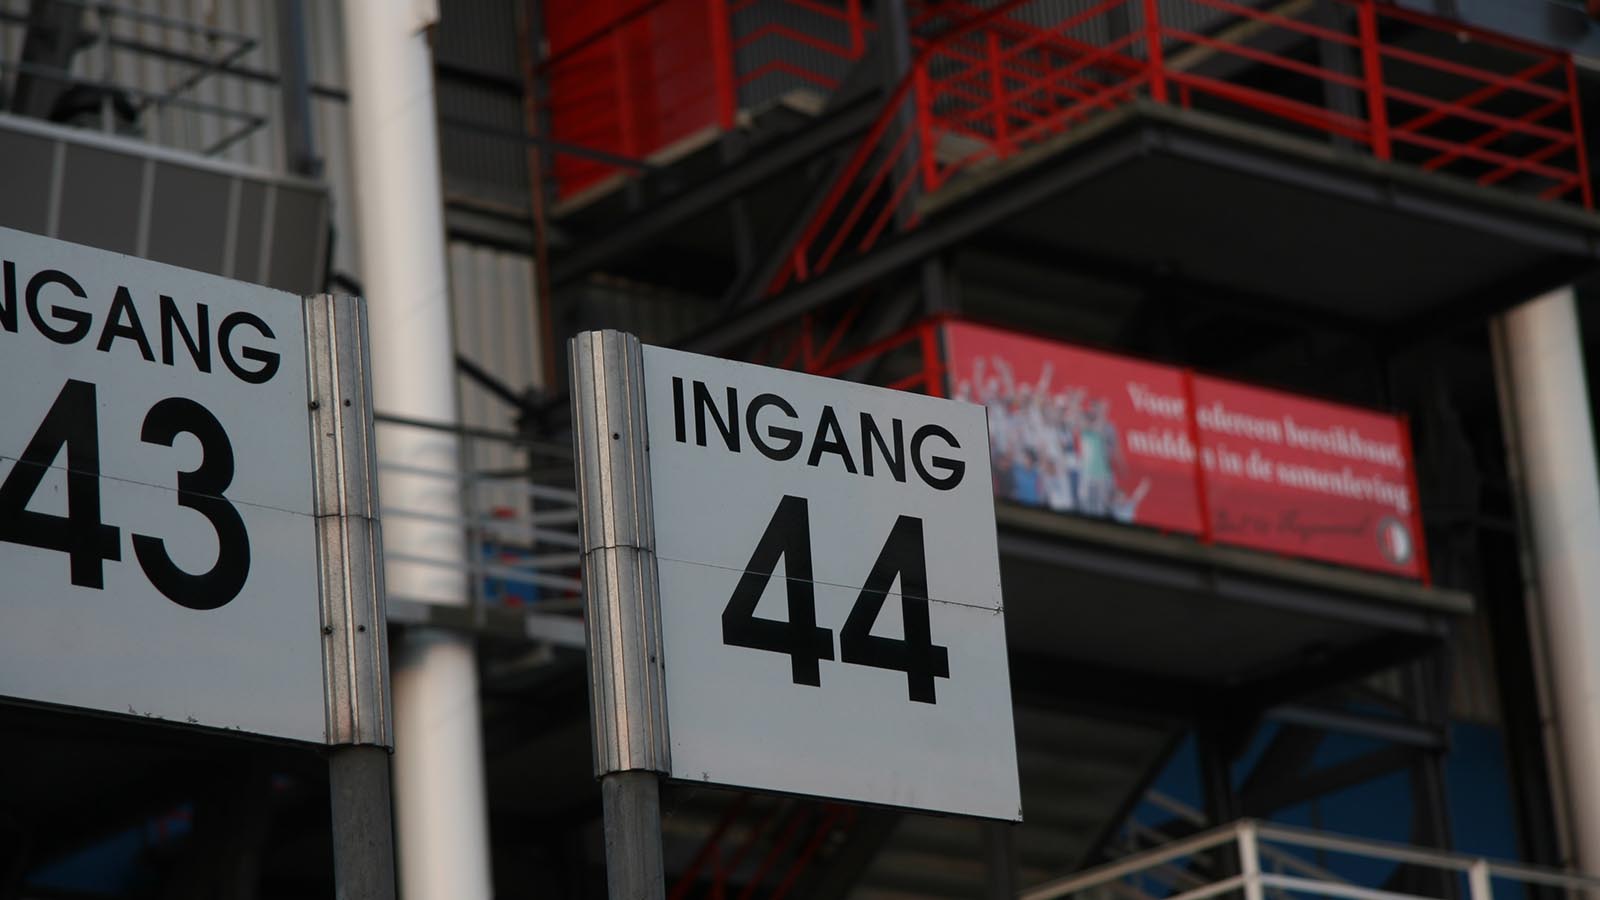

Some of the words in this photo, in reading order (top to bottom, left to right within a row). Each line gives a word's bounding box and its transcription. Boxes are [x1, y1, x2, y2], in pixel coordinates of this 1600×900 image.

[672, 376, 966, 491] INGANG
[1126, 381, 1185, 421] Voor
[1194, 401, 1282, 445] edereen
[0, 378, 251, 611] 43
[1217, 443, 1243, 477] in
[1245, 448, 1273, 483] de
[1276, 462, 1411, 516] samenleving
[721, 494, 950, 705] 44
